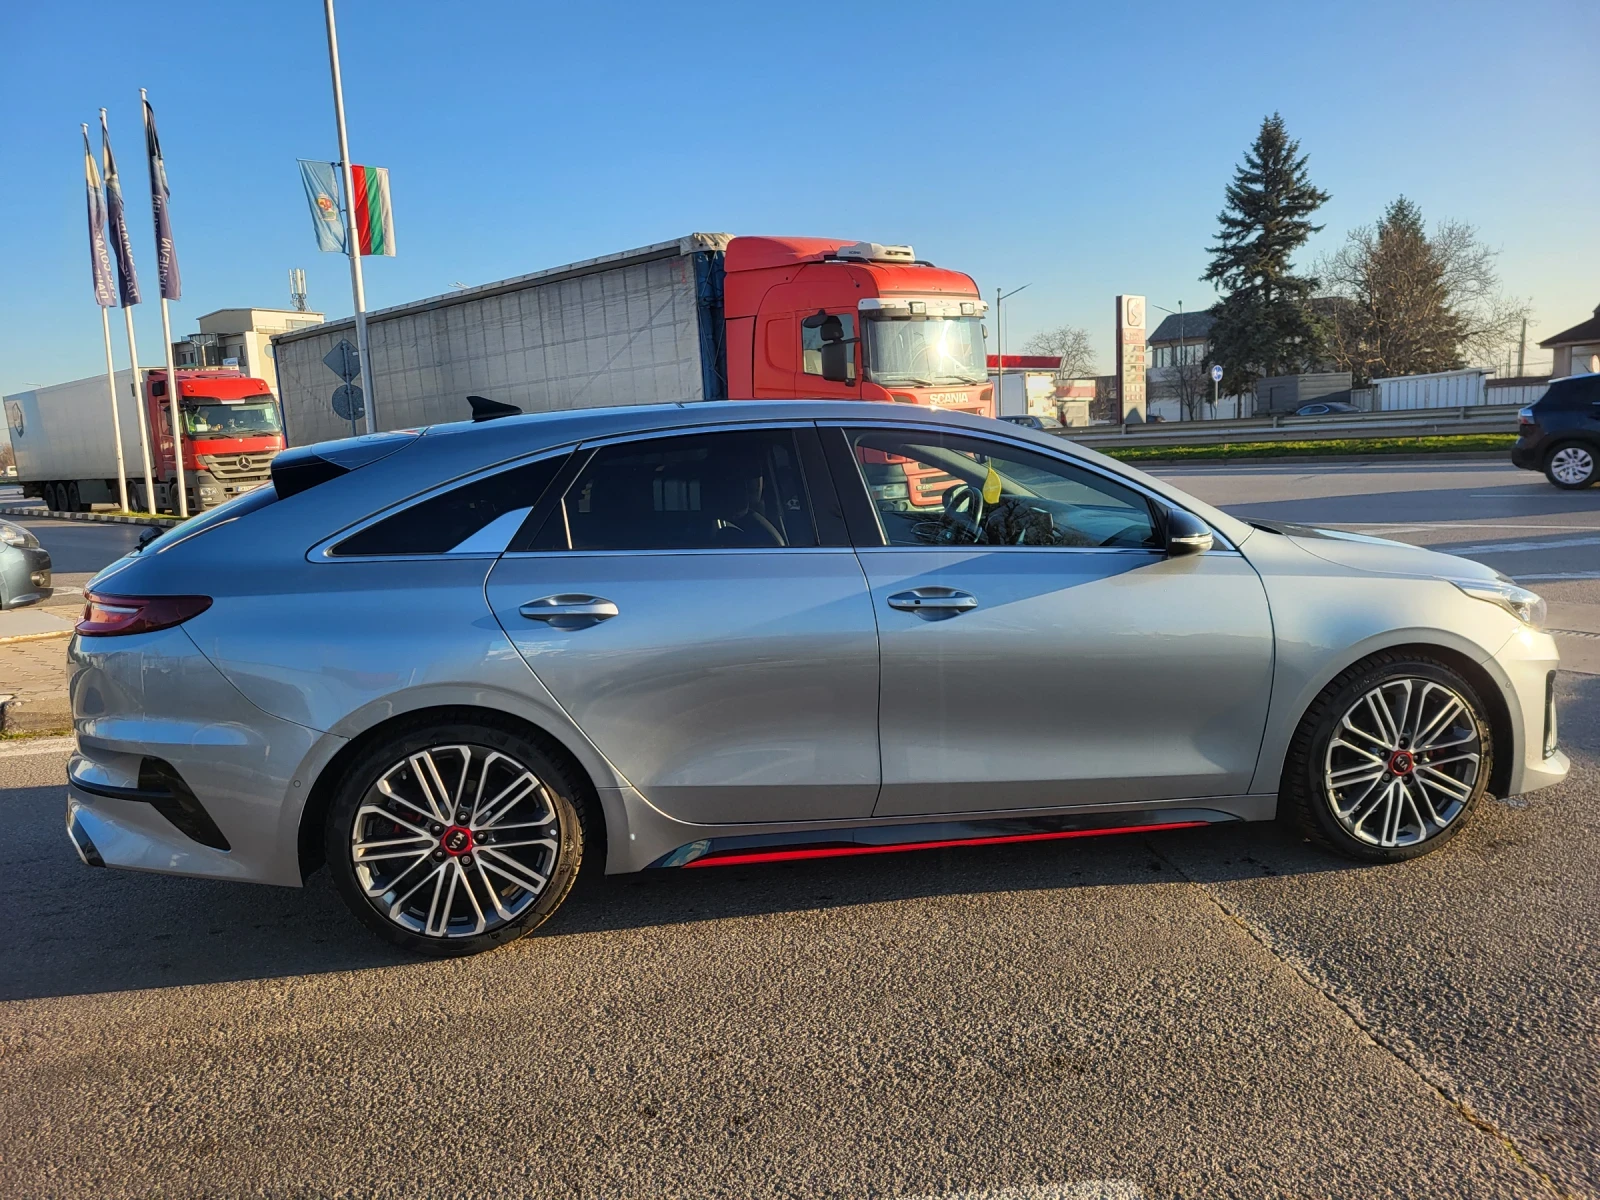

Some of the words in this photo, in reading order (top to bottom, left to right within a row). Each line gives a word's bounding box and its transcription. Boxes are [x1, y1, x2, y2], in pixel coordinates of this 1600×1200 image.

[929, 392, 969, 405] SCANIA
[1395, 756, 1408, 771] KIA
[449, 832, 465, 849] KIA
